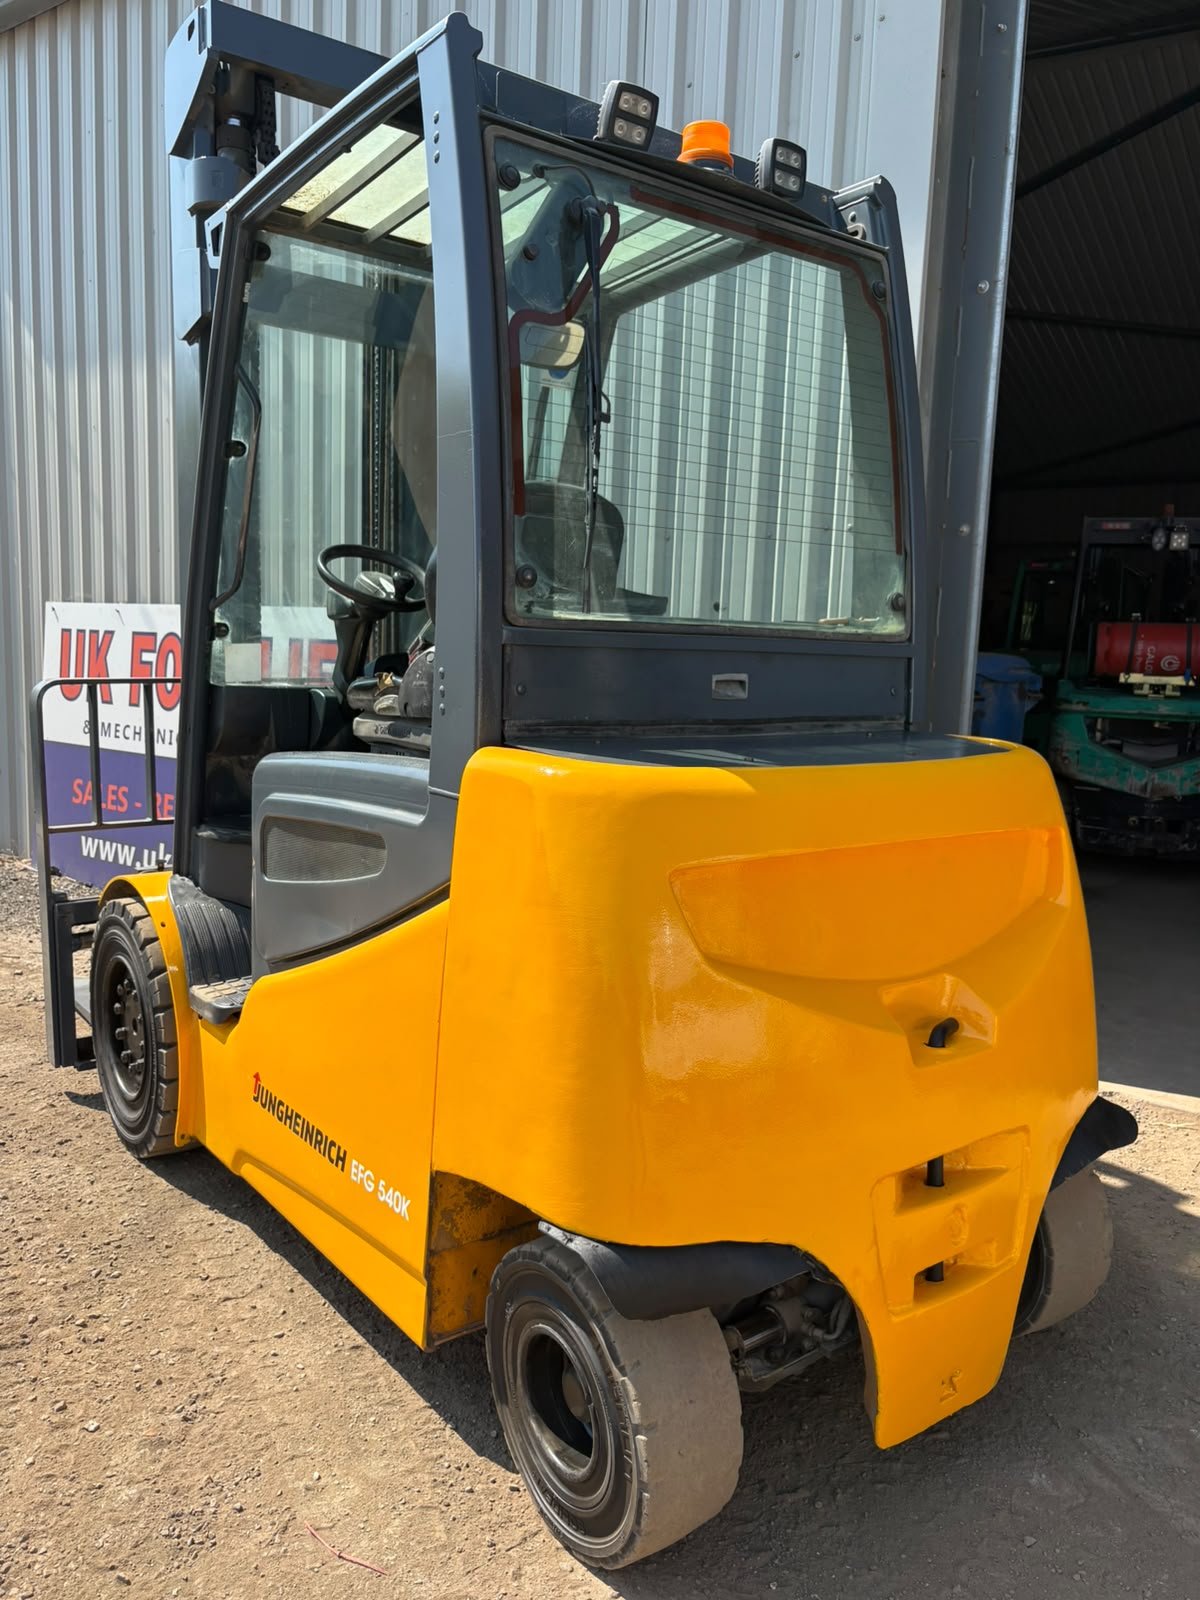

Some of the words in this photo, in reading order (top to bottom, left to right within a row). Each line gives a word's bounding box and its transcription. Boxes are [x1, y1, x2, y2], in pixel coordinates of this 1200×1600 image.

[60, 628, 115, 705] UK
[1144, 646, 1156, 674] CALO
[100, 721, 179, 746] MECHNI
[252, 1083, 348, 1173] JUNGHEINRICH
[350, 1159, 375, 1193] EFG
[377, 1179, 411, 1221] 540K
